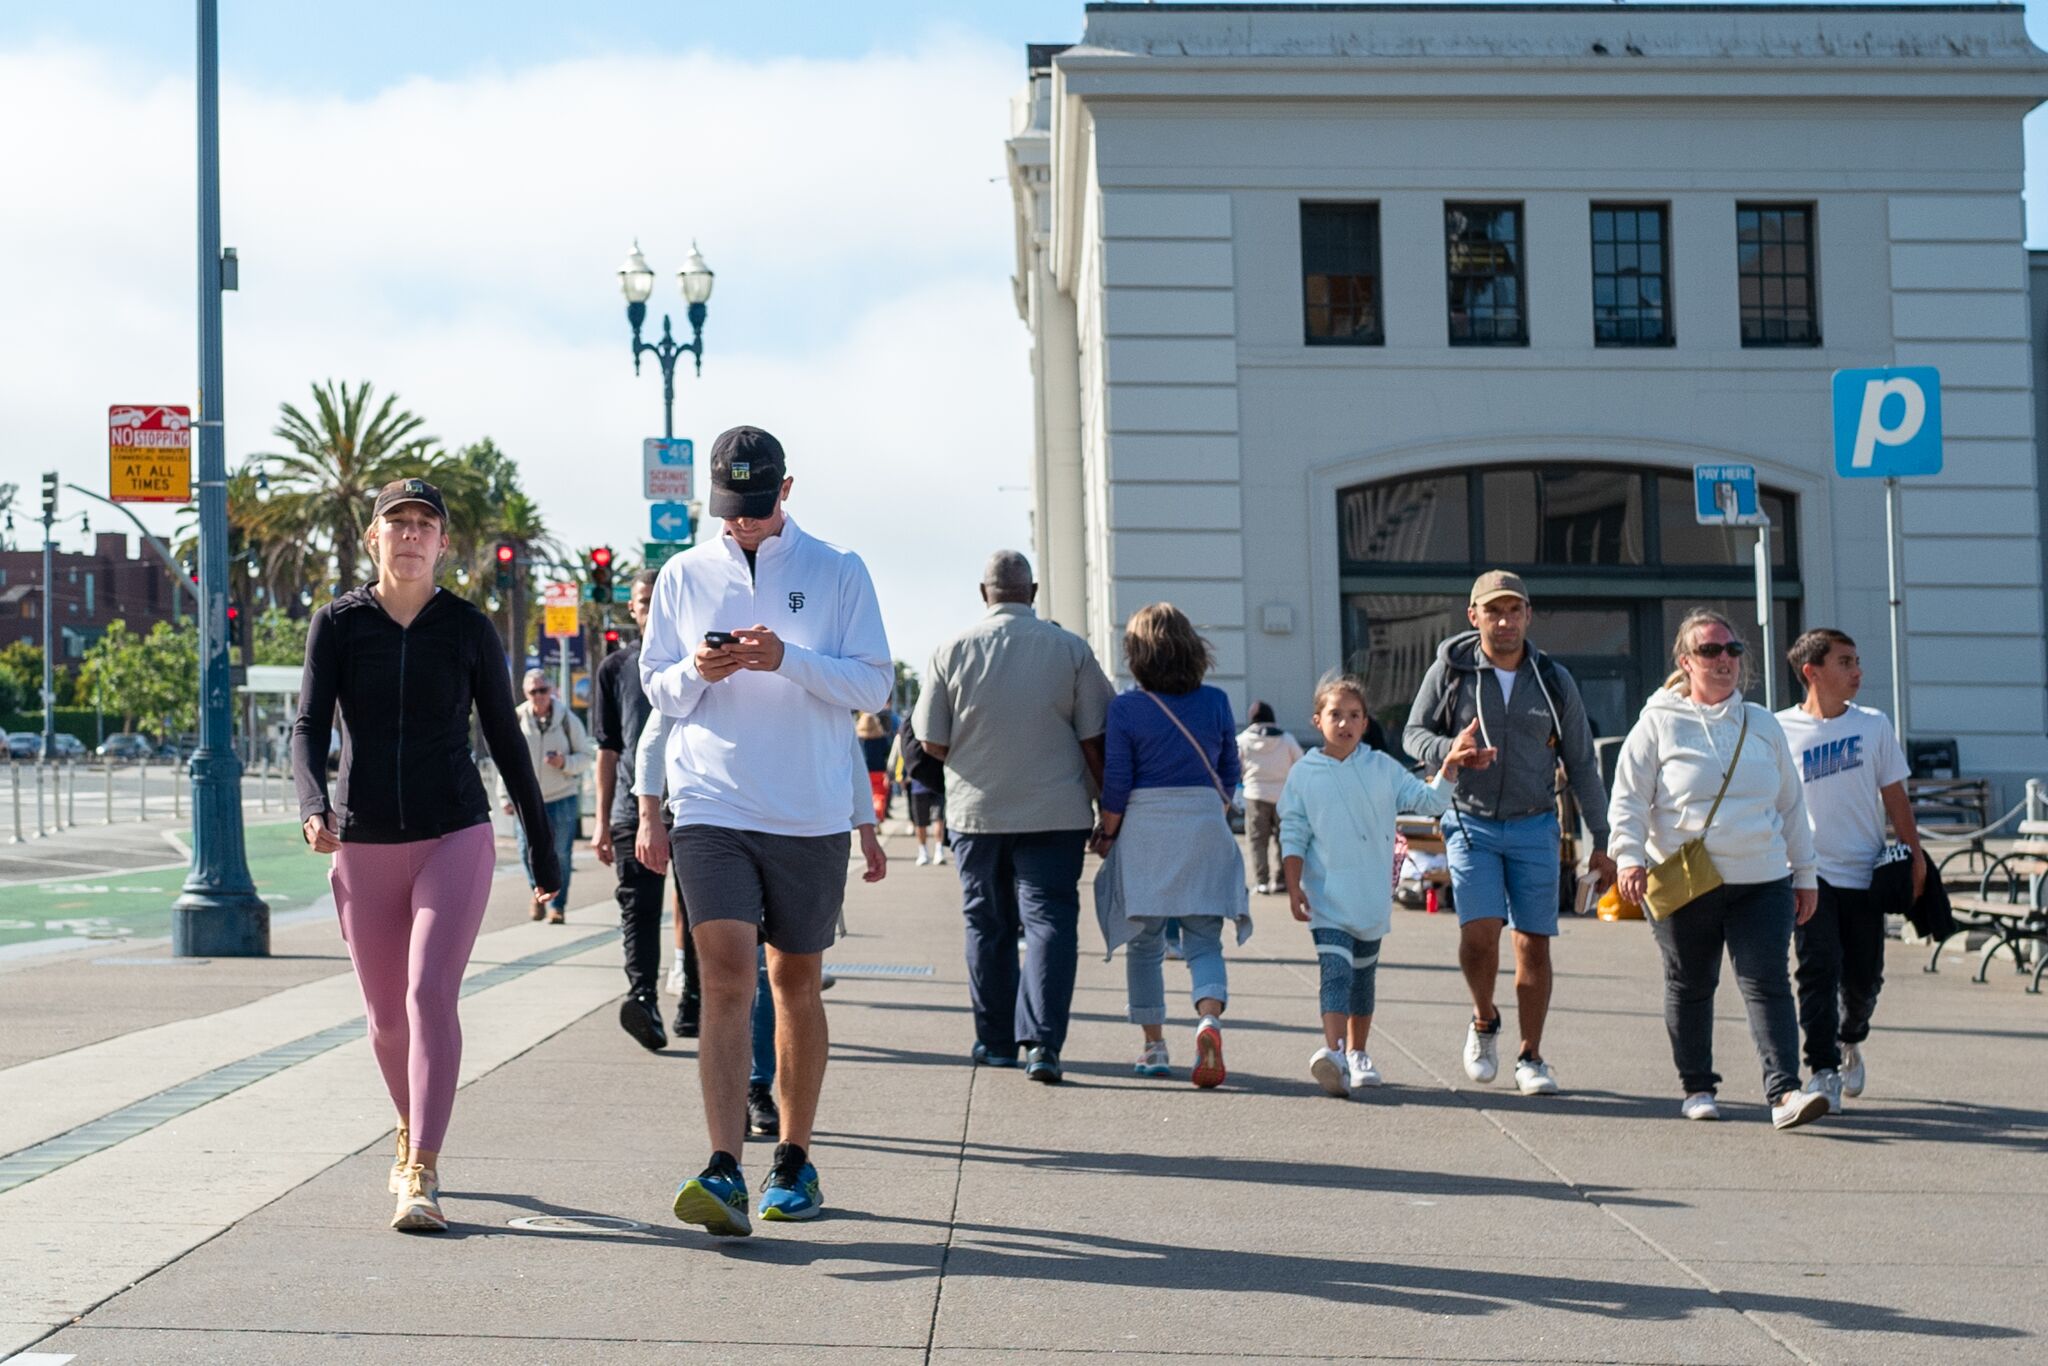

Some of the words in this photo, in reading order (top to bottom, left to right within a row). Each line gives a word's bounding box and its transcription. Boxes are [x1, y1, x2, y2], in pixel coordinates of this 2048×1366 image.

[111, 427, 134, 446] NO
[136, 431, 188, 446] STOPPING
[667, 442, 690, 461] 49
[126, 464, 142, 477] AT
[149, 464, 175, 478] ALL
[649, 469, 689, 481] SCENIC
[1698, 468, 1719, 480] PAY
[1721, 468, 1751, 480] HERE
[131, 478, 170, 491] TIMES
[649, 483, 688, 495] DRIVE
[788, 591, 806, 613] SF
[1802, 735, 1863, 783] NIKE
